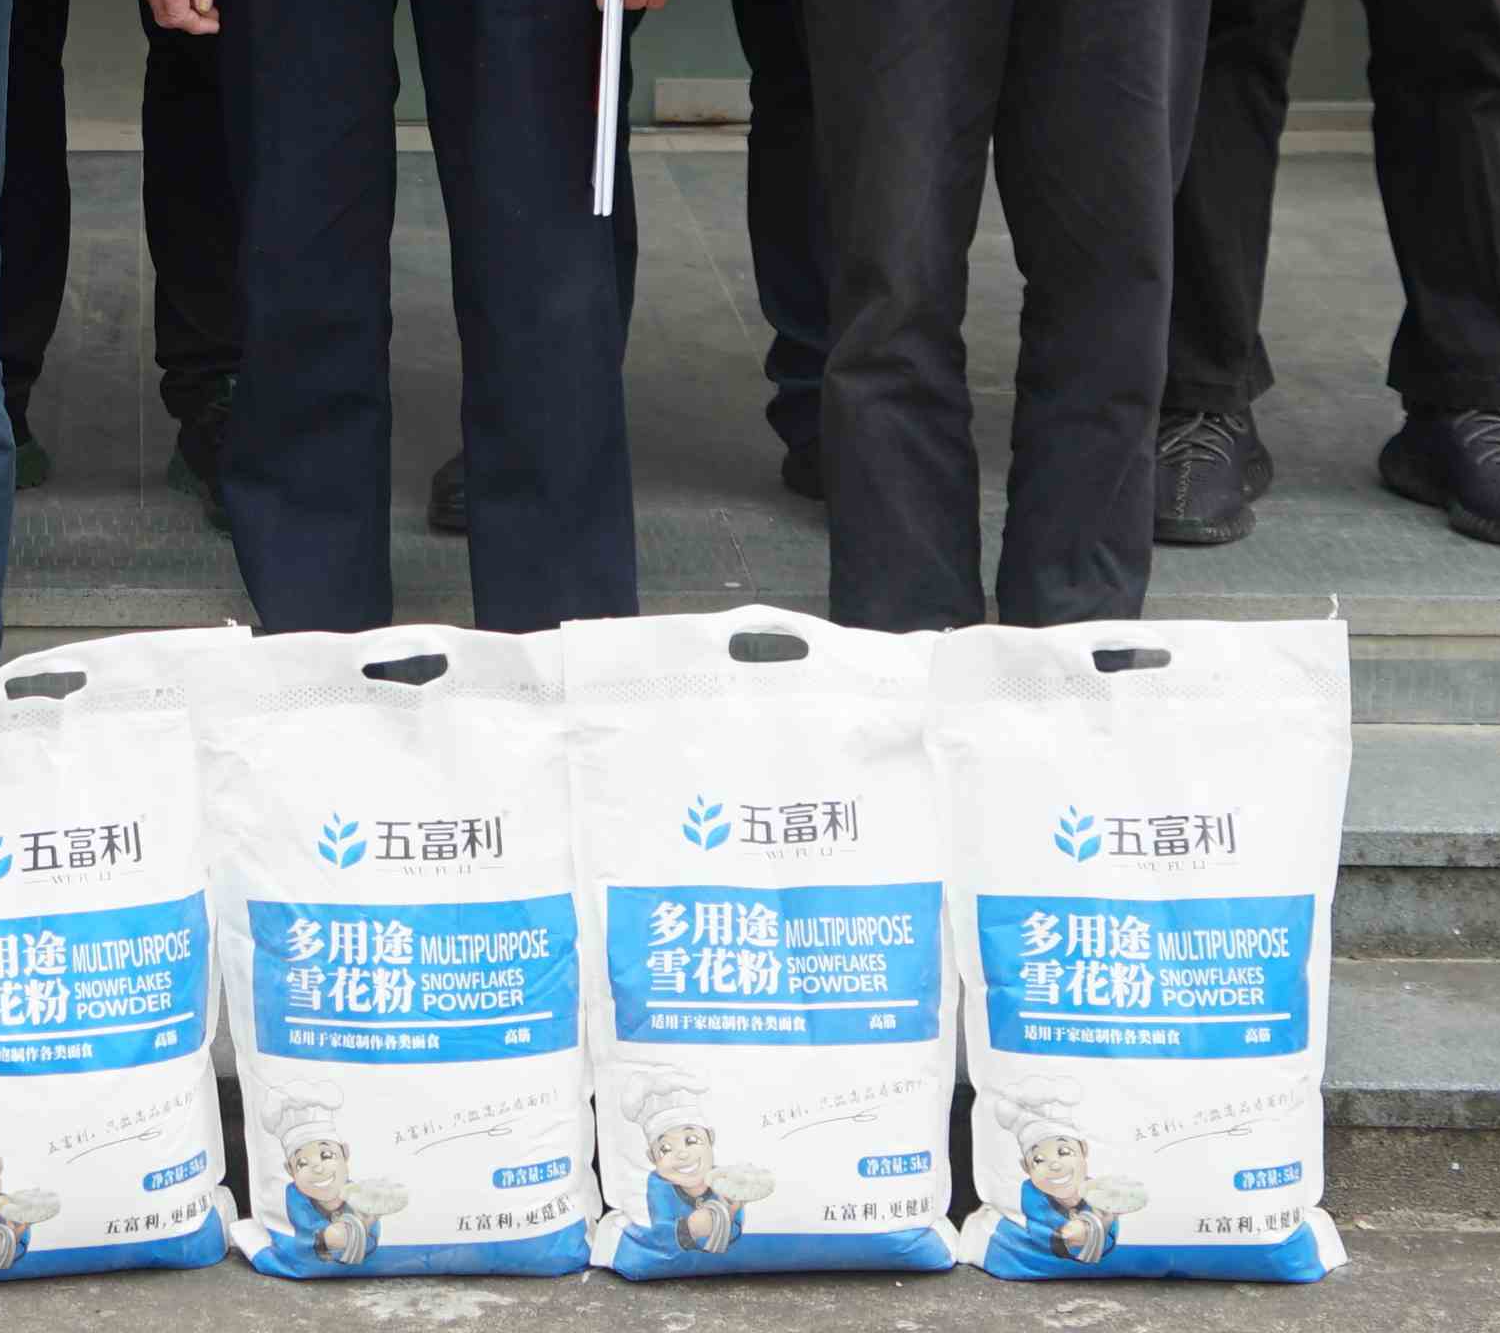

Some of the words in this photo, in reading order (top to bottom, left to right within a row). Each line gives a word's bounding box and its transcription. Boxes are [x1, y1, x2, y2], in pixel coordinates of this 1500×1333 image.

[374, 815, 503, 862] 五富利
[740, 799, 860, 845] 五富利
[1104, 812, 1238, 858] 五富利
[19, 820, 143, 873] 五富利
[286, 918, 414, 966] 多用途
[647, 901, 779, 949] 多用途
[784, 914, 914, 949] MULTIPURPOSE
[1020, 911, 1152, 961] 多用途
[1157, 927, 1290, 963] MULTIPURPOSE
[72, 928, 191, 975] MULTIPURPOSE
[420, 927, 550, 967] MULTIPURPOSE
[787, 952, 887, 975] SNOWFLAKES
[74, 971, 172, 1001] SNOWFLAKES
[286, 966, 416, 1014] 雪花粉
[421, 967, 525, 991] SNOWFLAKES
[646, 948, 780, 996] 雪花粉
[789, 973, 888, 995] POWDER
[1019, 960, 1154, 1009] 雪花粉
[1160, 966, 1265, 988] SNOWFLAKES
[76, 992, 172, 1021] POWDER
[423, 988, 525, 1012] POWDER
[1162, 987, 1265, 1008] POWDER
